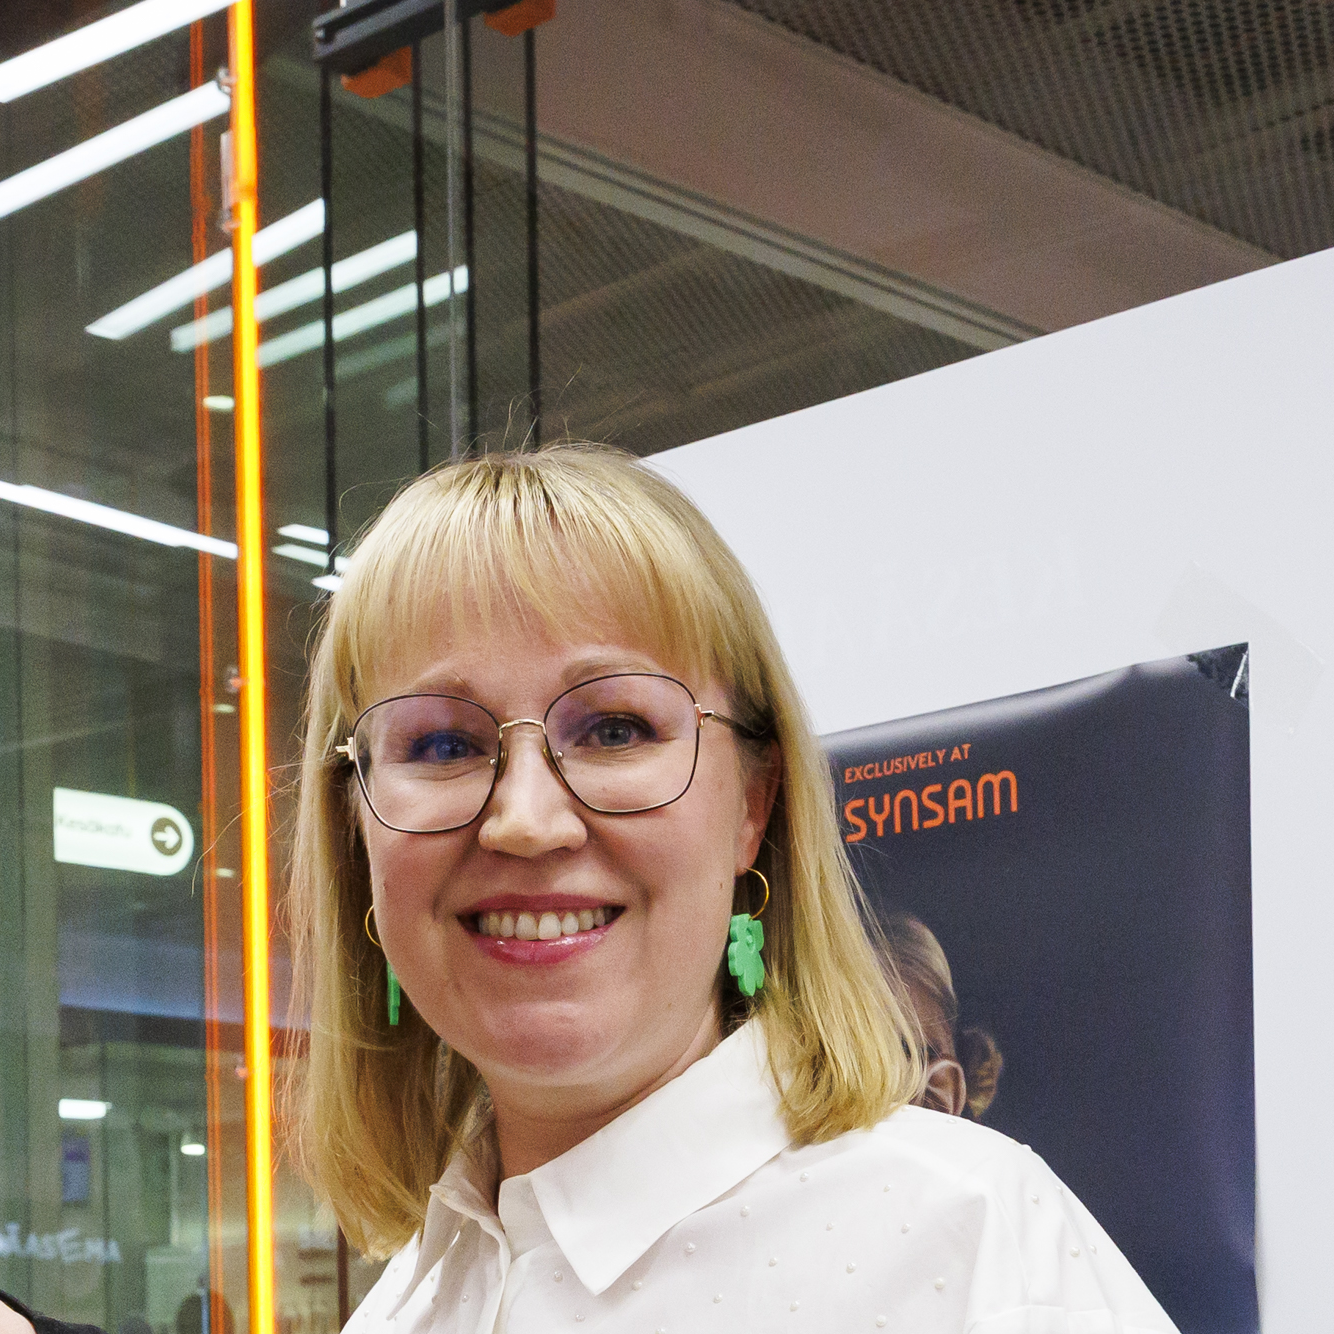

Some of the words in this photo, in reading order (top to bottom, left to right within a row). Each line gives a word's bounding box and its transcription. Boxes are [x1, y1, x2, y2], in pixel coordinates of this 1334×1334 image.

[844, 749, 947, 784] EXCLUSIVELY
[950, 743, 972, 762] AT
[844, 769, 1019, 843] SYNSAM
